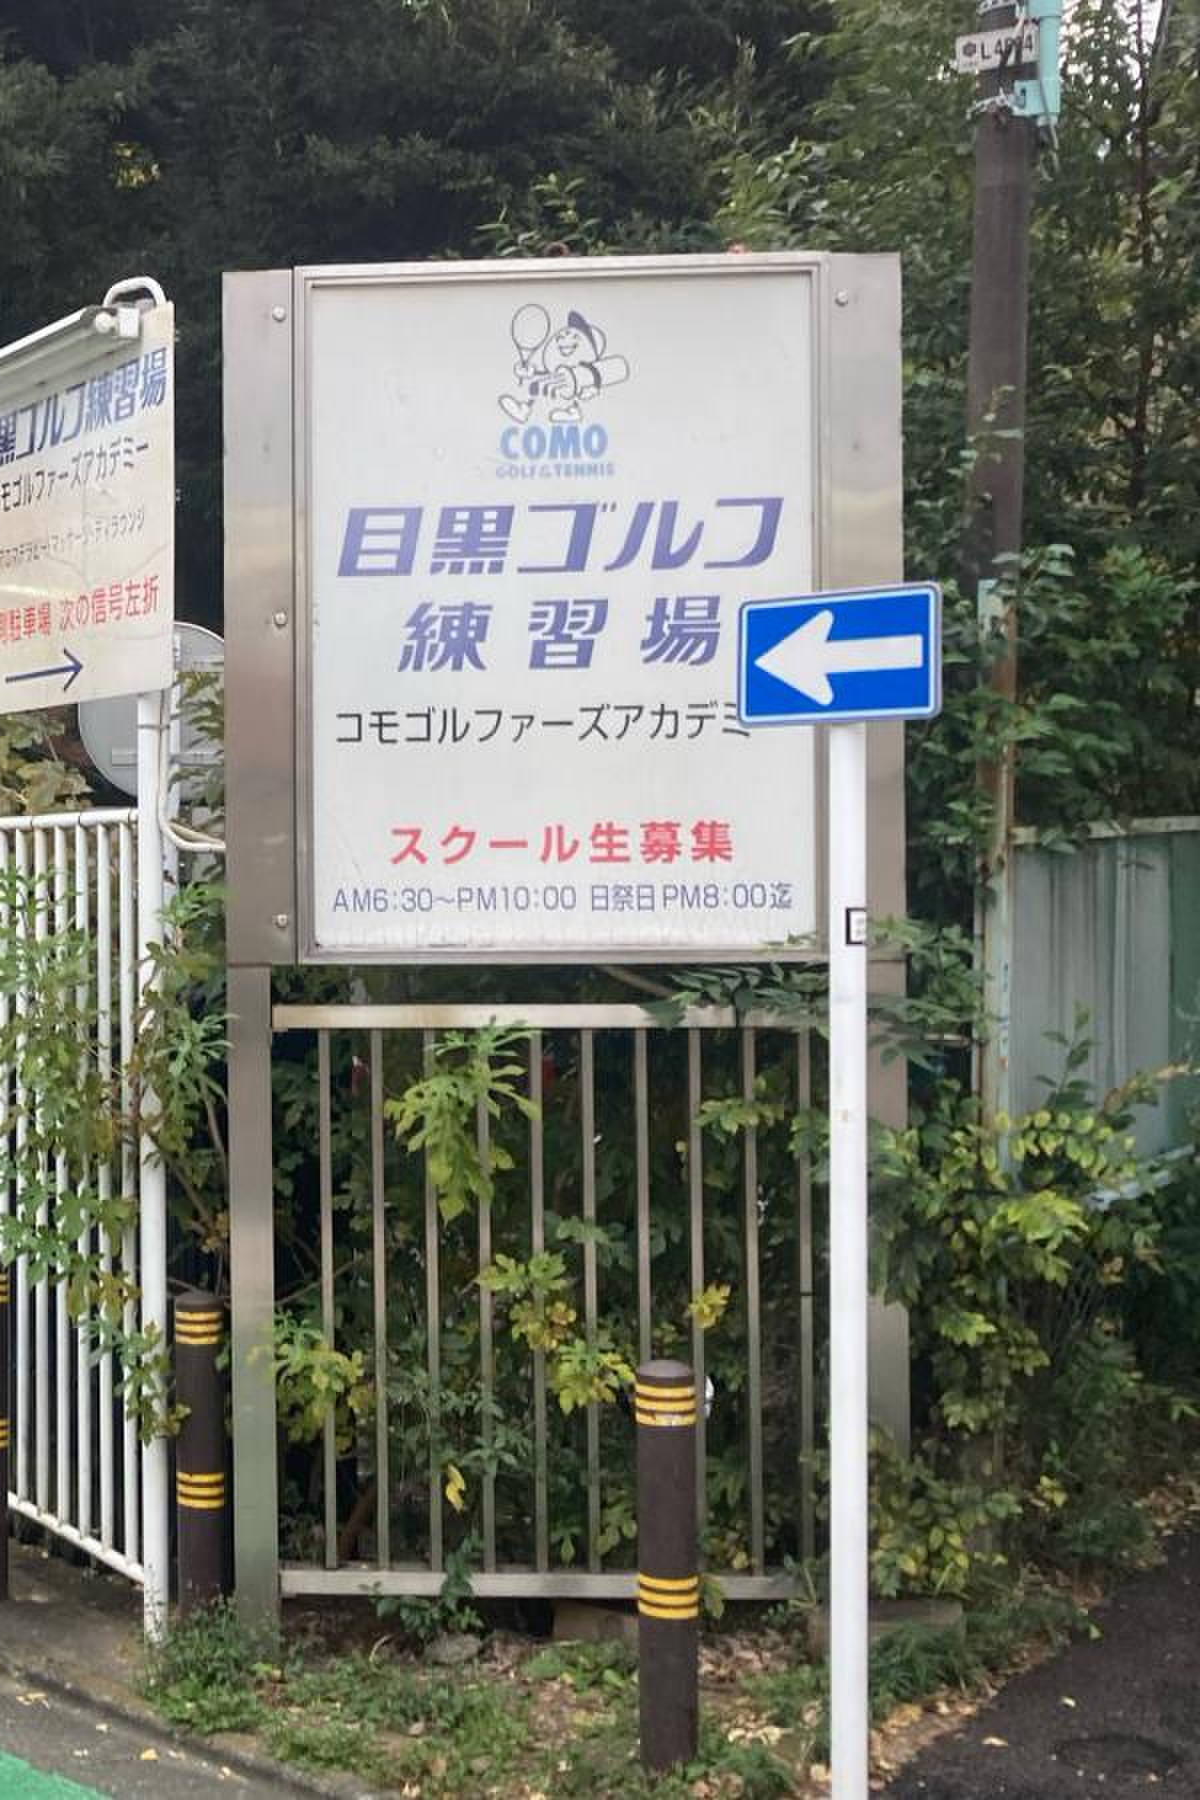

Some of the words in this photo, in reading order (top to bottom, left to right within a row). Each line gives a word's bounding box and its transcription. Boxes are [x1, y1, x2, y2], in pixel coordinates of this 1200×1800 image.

[500, 423, 608, 460] COMO
[336, 496, 785, 577] 目黒ゴルフ
[58, 574, 161, 631] 次の信号左折
[397, 594, 722, 673] 練習場
[335, 701, 751, 745] コモゴルファーズアカデミ
[389, 819, 735, 866] スクール生募集
